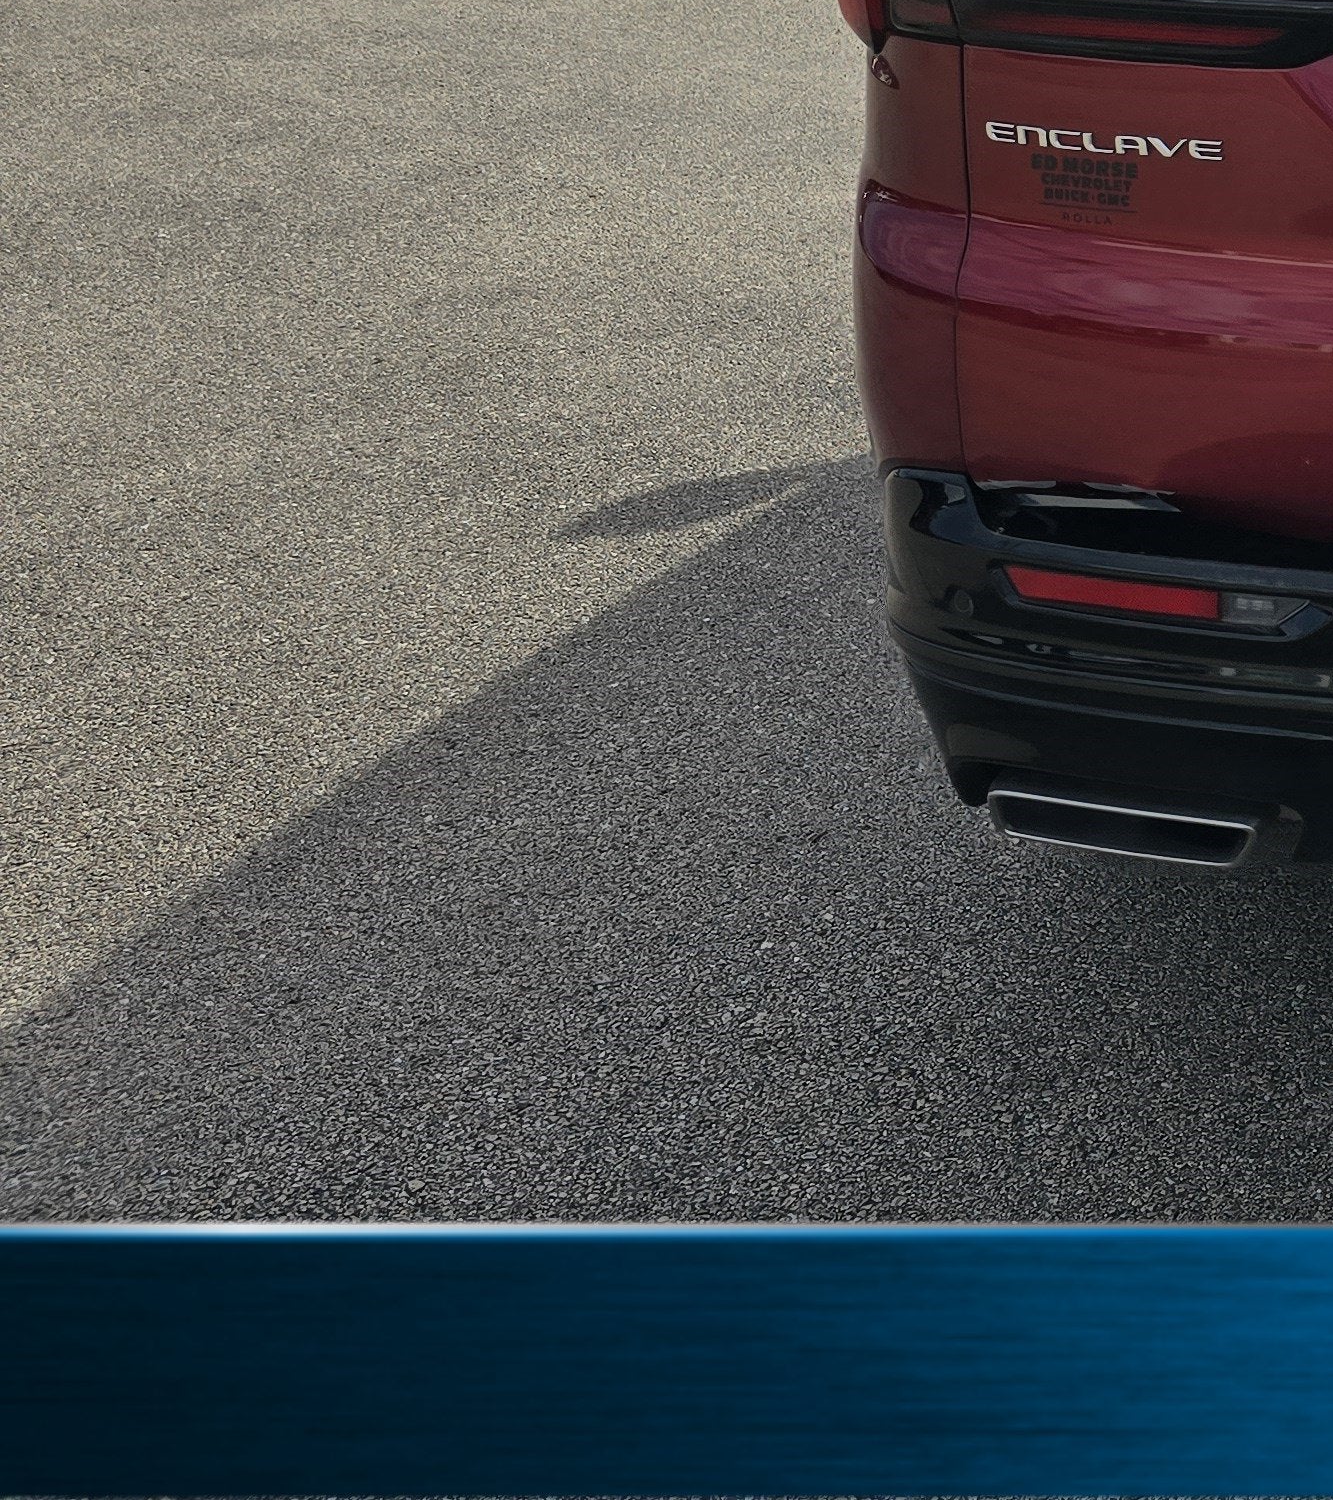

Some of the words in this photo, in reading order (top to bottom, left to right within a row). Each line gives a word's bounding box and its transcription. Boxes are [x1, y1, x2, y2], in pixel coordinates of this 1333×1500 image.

[985, 121, 1223, 161] ENCLAVE
[1031, 153, 1057, 171] ED
[1063, 157, 1138, 179] MORSE
[1041, 172, 1132, 192] CHEVROLET
[1044, 187, 1089, 203] BUICK
[1098, 192, 1130, 207] GMC
[1063, 212, 1112, 225] ROLLA
